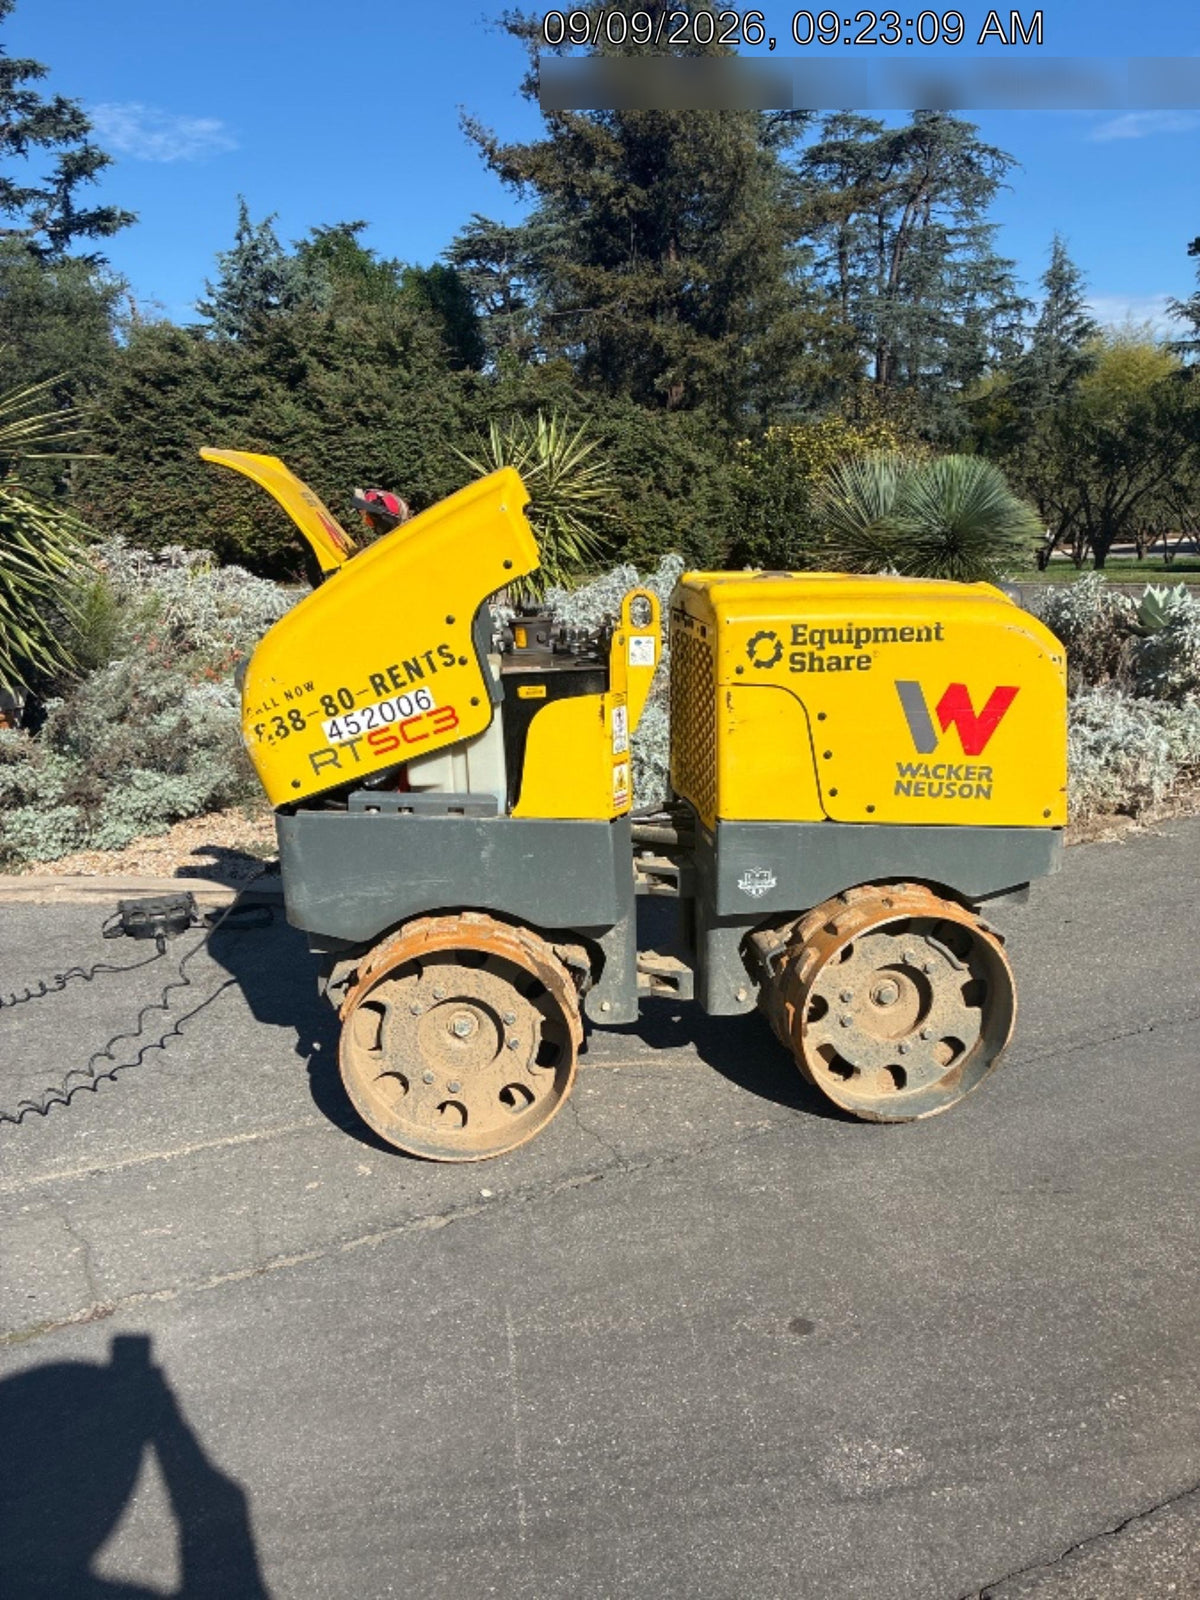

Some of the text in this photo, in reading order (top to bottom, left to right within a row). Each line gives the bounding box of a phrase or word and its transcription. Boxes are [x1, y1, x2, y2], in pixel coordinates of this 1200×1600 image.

[790, 622, 945, 650] Equipment
[788, 651, 873, 673] Share
[283, 681, 315, 701] NOW
[327, 688, 432, 740] 452006
[895, 762, 993, 783] WACKER
[893, 780, 993, 800] NEUSON
